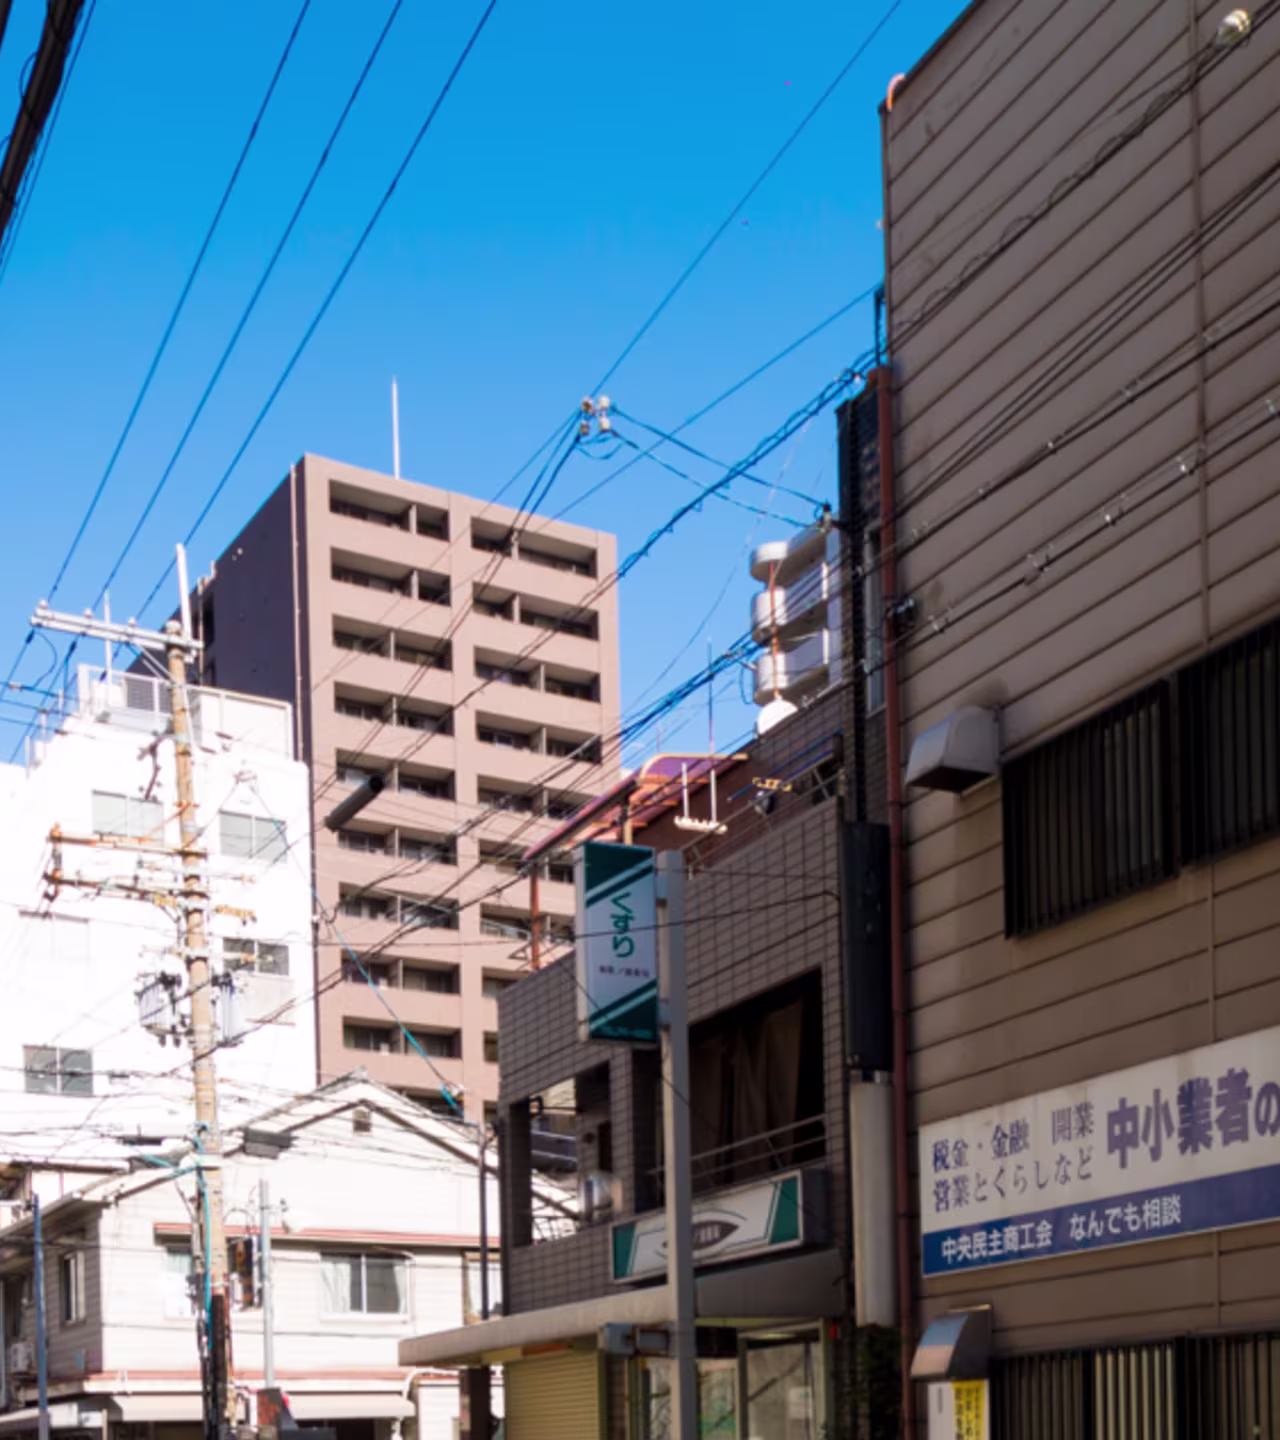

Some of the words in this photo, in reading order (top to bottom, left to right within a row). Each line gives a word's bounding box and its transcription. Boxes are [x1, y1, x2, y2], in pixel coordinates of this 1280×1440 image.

[933, 1147, 1093, 1213] 営業とくらしなど
[940, 1219, 1053, 1264] 中央民主商工会
[1068, 1193, 1182, 1242] なんでも相談
